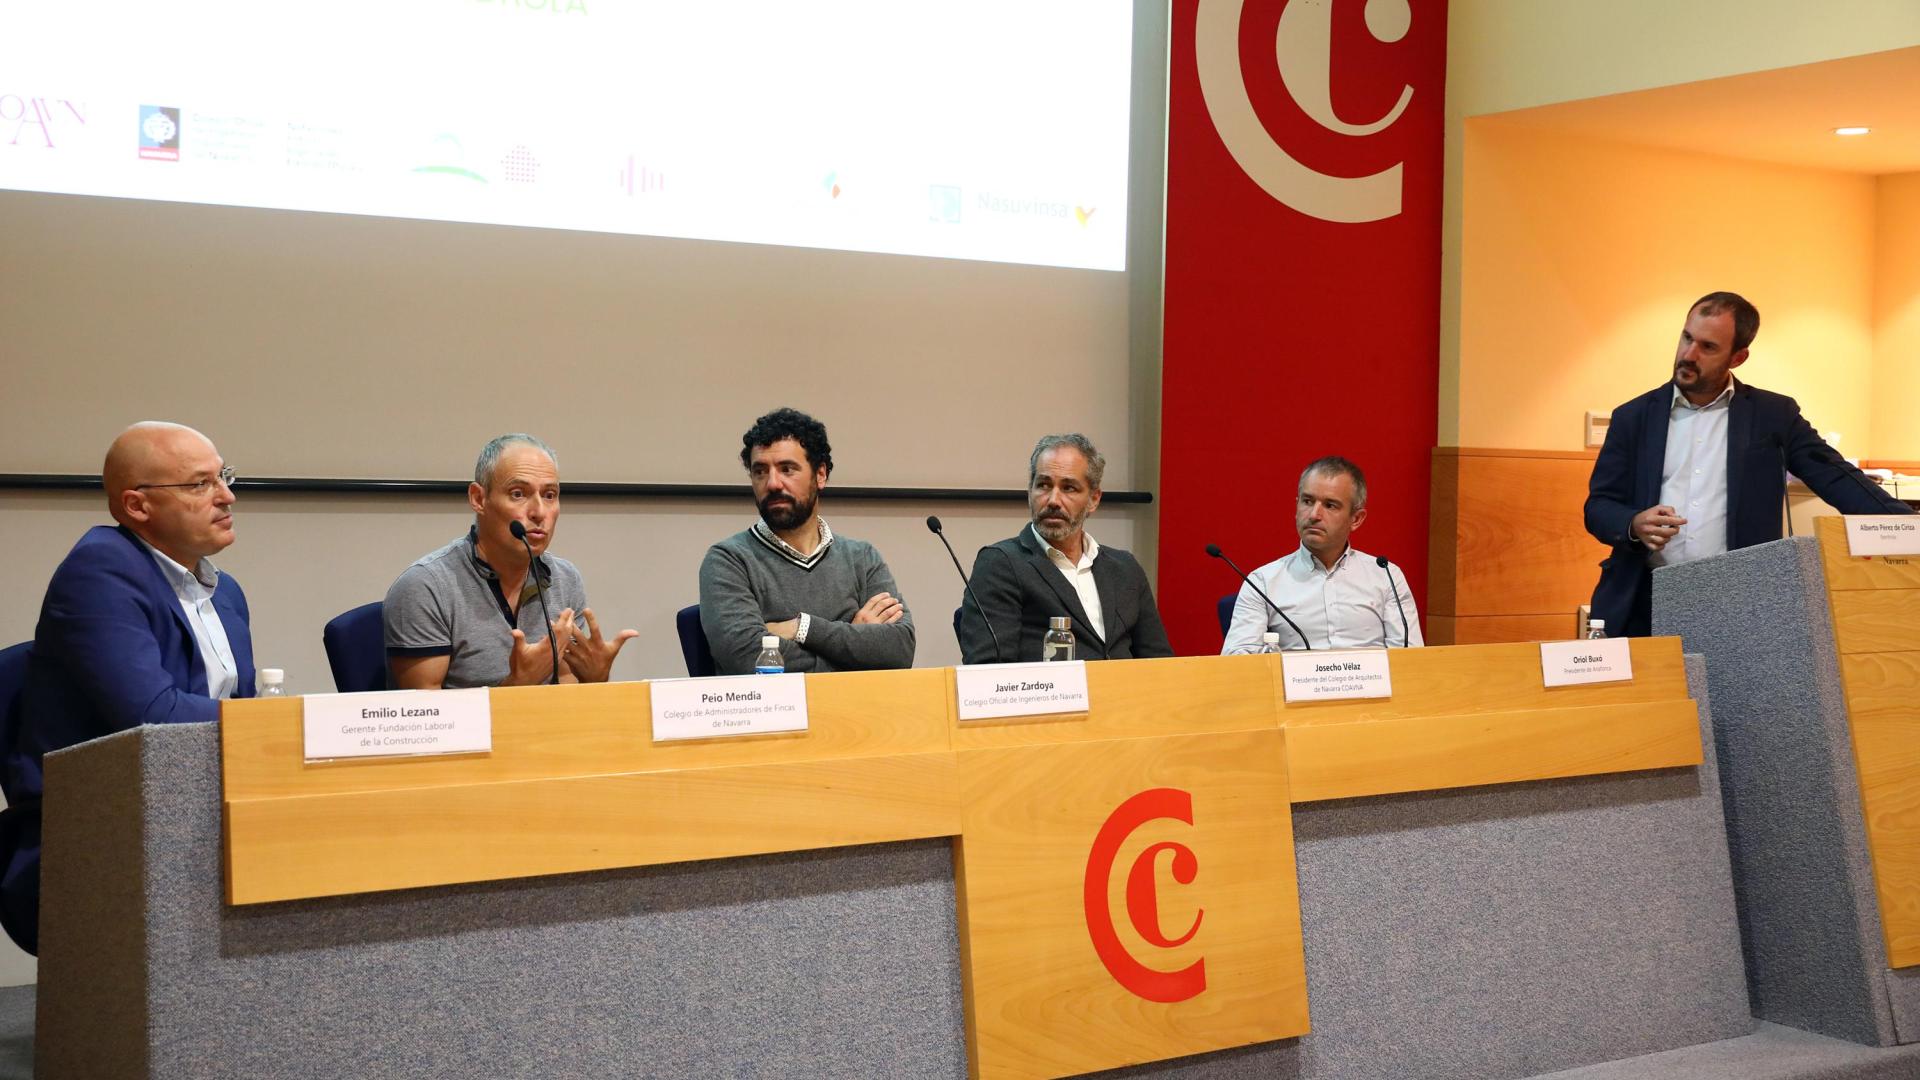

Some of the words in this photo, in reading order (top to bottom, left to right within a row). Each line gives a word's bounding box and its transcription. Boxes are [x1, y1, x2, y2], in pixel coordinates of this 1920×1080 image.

[977, 191, 1068, 218] Nasuvinsa
[1894, 523, 1901, 531] de
[1573, 656, 1588, 664] Oriol
[1588, 654, 1603, 663] Buxó
[1315, 663, 1342, 672] Josecho
[1342, 662, 1361, 671] Vélaz
[1292, 676, 1319, 684] Presidente
[1319, 675, 1328, 683] del
[1328, 675, 1347, 684] Colegio
[1355, 673, 1383, 683] Arquitectos
[995, 682, 1019, 693] Javier
[1021, 681, 1054, 692] Zardoya
[1321, 685, 1341, 693] Navarra
[702, 693, 723, 704] Peio
[725, 690, 762, 702] Mendia
[964, 697, 988, 708] Colegio
[988, 696, 1008, 705] Oficial
[1009, 695, 1018, 704] de
[1018, 694, 1050, 705] Ingenieros
[1050, 693, 1058, 702] de
[1059, 692, 1083, 701] Navarra
[361, 707, 398, 719] Emilio
[401, 706, 440, 718] Lezana
[663, 709, 692, 720] Colegio
[693, 708, 704, 717] de
[704, 706, 762, 716] Administradores
[763, 704, 773, 713] de
[774, 703, 796, 712] Fincas
[341, 725, 377, 735] Gerente
[378, 722, 423, 733] Fundación
[424, 720, 455, 731] Laboral
[712, 719, 722, 729] de
[723, 718, 751, 728] Navarra
[360, 737, 371, 747] de
[373, 737, 382, 746] la
[383, 734, 439, 746] Construcción
